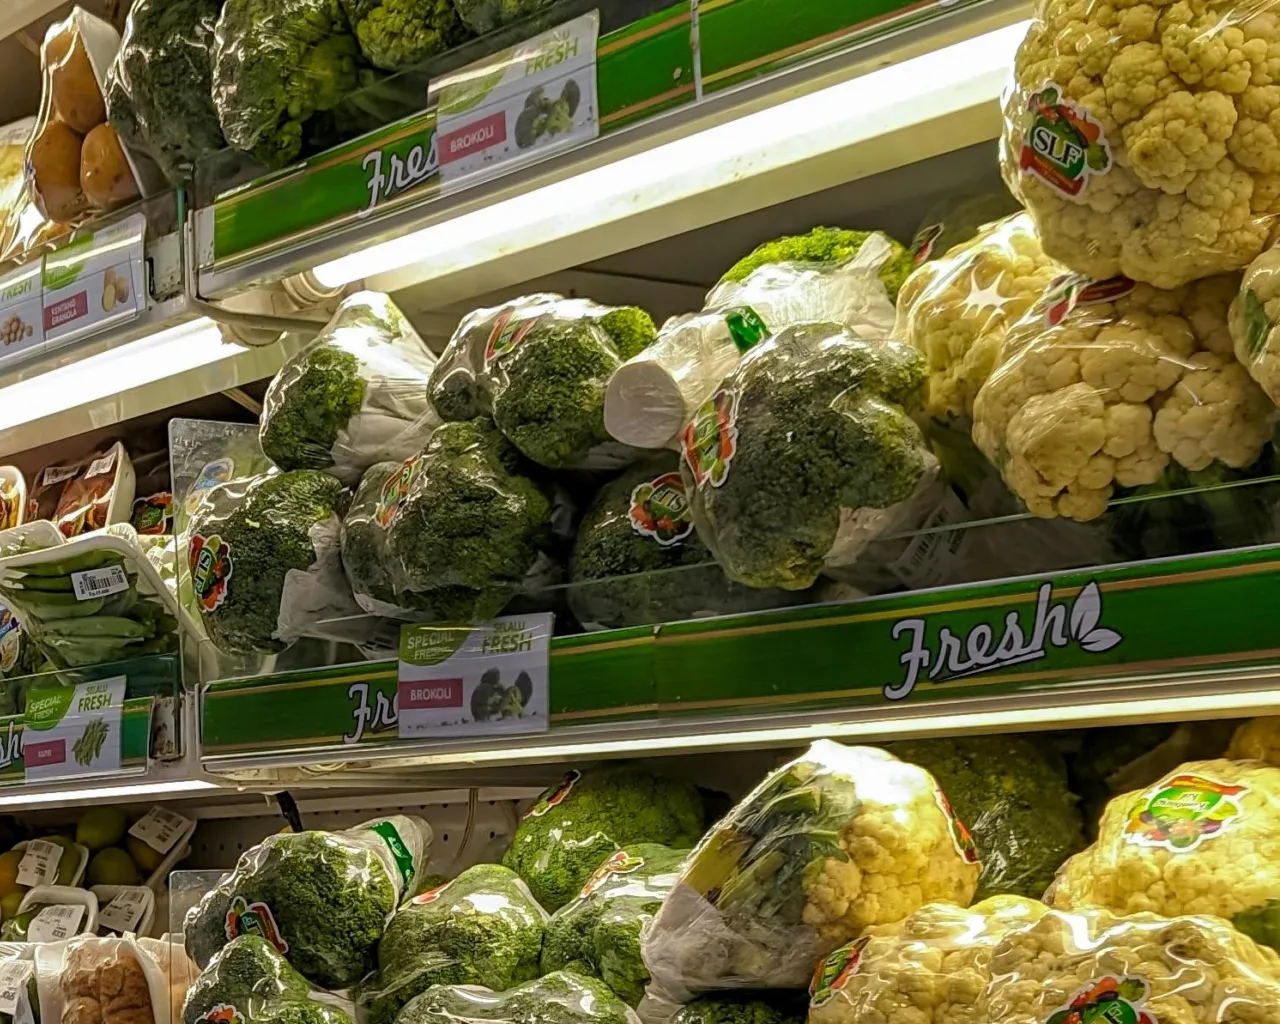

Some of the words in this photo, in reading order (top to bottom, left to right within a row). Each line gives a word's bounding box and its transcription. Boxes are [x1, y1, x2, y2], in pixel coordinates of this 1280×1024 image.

[449, 124, 495, 153] BROKOLI
[1033, 127, 1082, 167] SLF
[357, 132, 438, 217] Fres
[407, 630, 455, 649] SPECIAL
[481, 633, 533, 655] FRESH
[883, 580, 1068, 700] Fresh
[30, 695, 61, 712] SPECIAL
[78, 693, 112, 712] FRESH
[410, 687, 452, 701] BROKOLI
